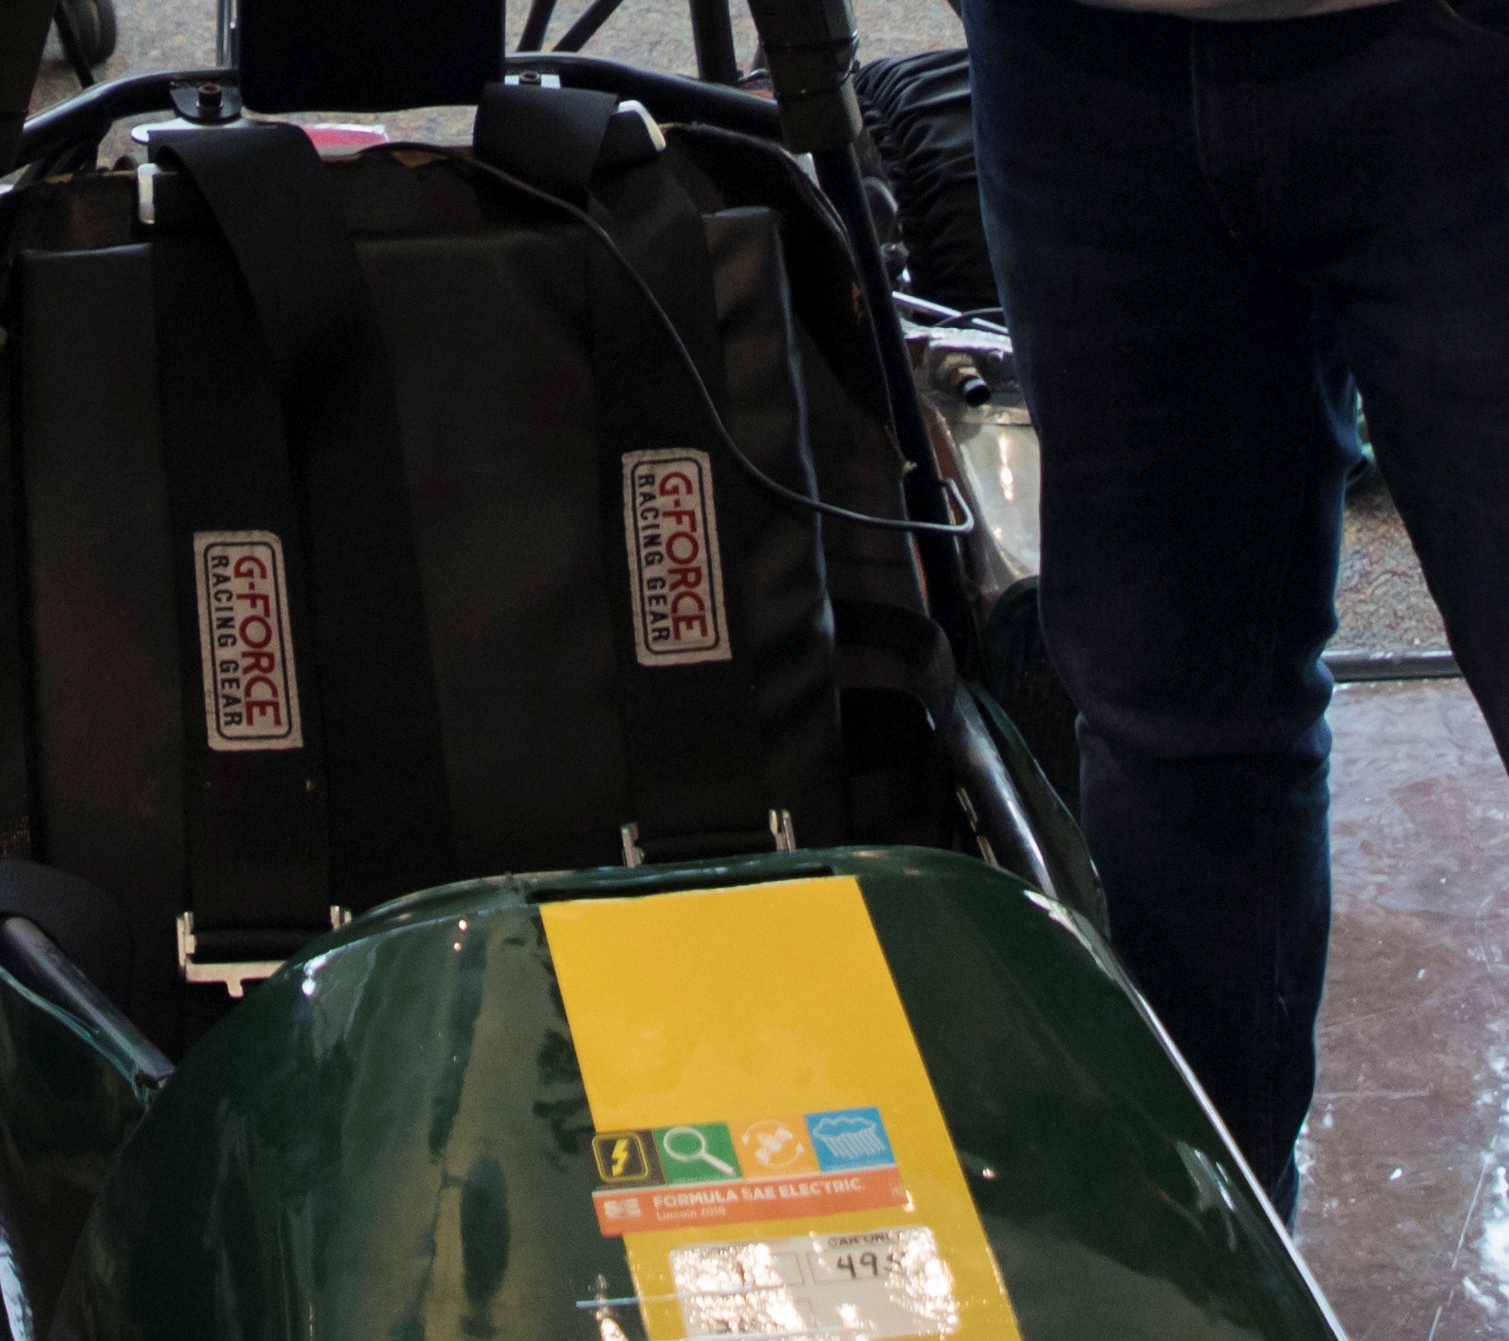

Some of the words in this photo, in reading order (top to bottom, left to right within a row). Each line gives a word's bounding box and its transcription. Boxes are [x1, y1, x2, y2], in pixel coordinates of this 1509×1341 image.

[637, 473, 664, 566] RACING
[659, 471, 709, 641] G-FORCE
[210, 554, 237, 648] RACING
[233, 554, 282, 728] G-FORCE
[647, 577, 671, 644] GEAR
[219, 659, 244, 728] GEAR
[652, 1189, 738, 1209] FORMULA
[742, 1184, 775, 1203] SAE
[780, 1177, 862, 1200] ELECTRIC
